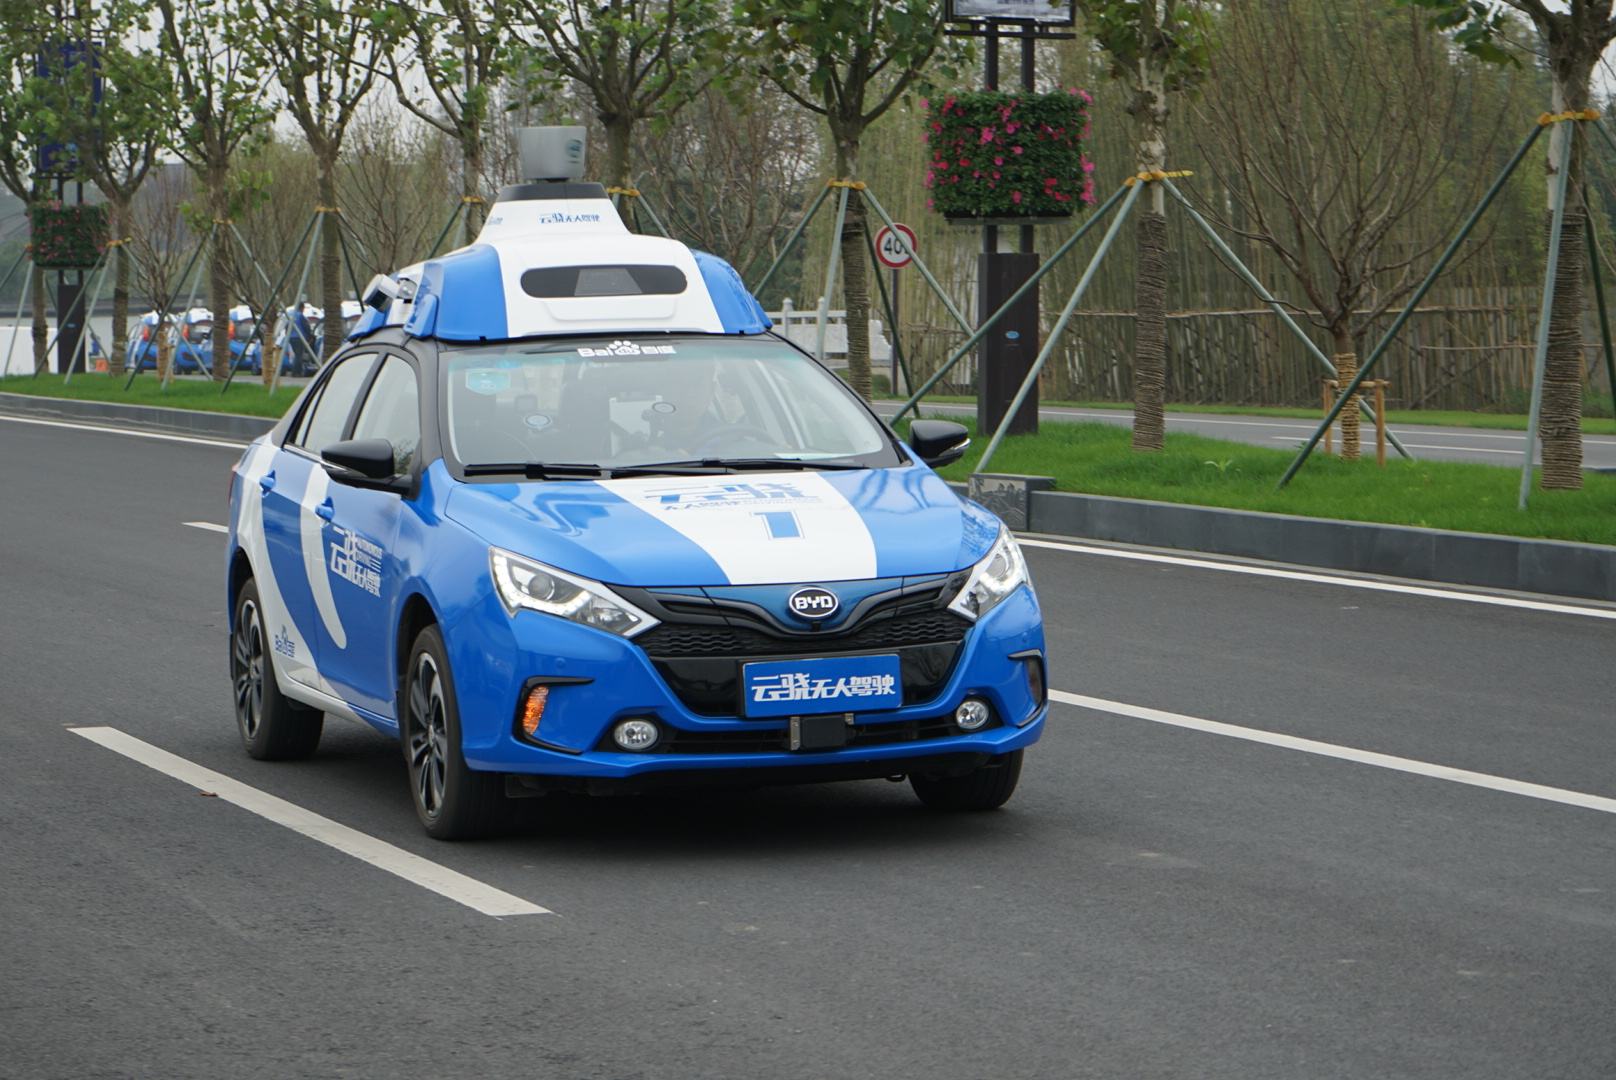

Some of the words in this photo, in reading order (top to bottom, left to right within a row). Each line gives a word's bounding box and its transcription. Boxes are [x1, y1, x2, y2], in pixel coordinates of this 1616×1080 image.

[795, 595, 833, 610] BYD
[751, 672, 896, 702] 云骁无人驾驶
